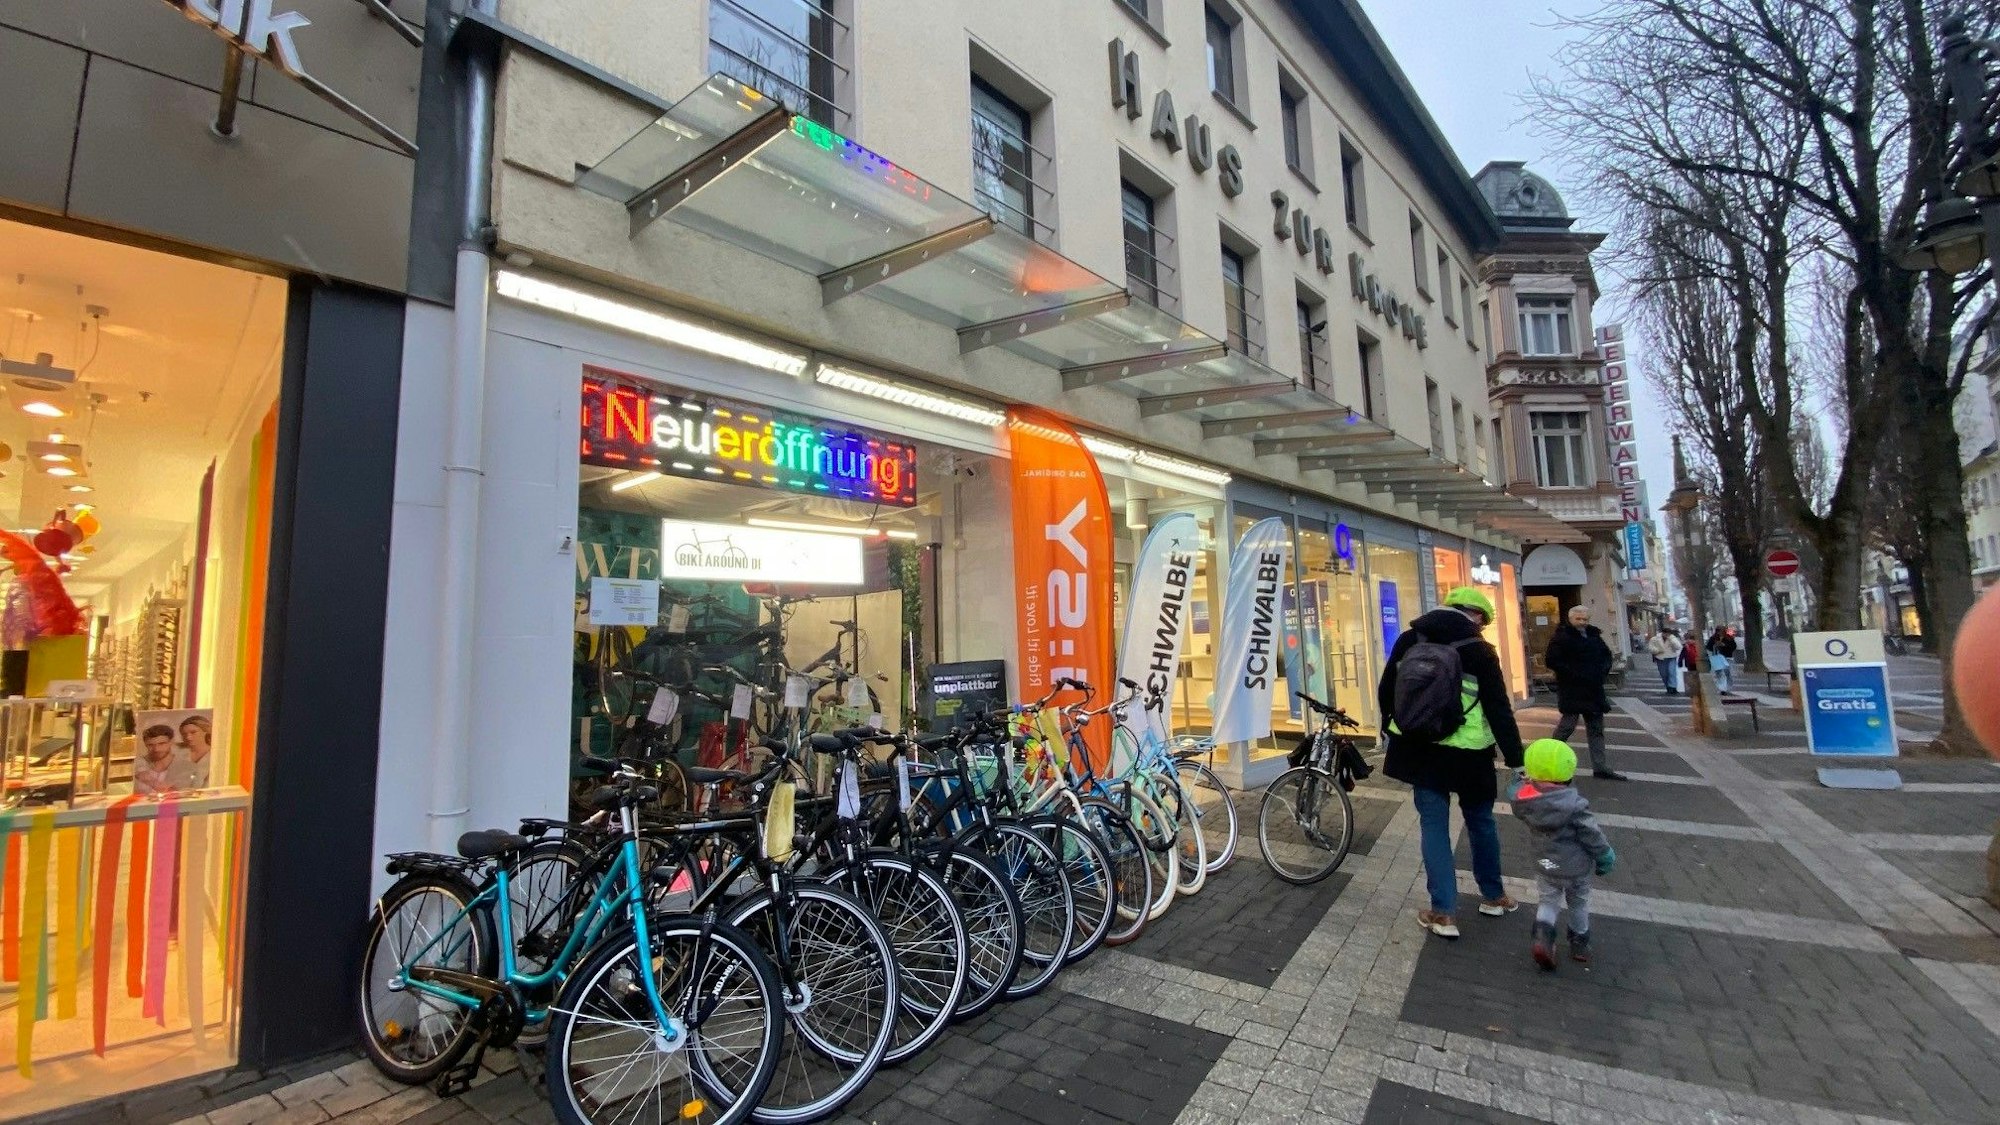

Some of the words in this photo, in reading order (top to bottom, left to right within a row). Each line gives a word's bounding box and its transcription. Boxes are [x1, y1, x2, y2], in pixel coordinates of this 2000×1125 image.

[1108, 37, 1243, 199] HAUS
[1270, 188, 1335, 275] ZUR
[1348, 250, 1428, 351] KRONE
[604, 391, 900, 493] Neueröffnung
[1603, 326, 1640, 522] LEDERWAREN
[679, 552, 704, 567] BIKE
[704, 553, 749, 569] AROUND
[1145, 551, 1192, 713] SCHWALBE
[1245, 552, 1281, 690] SCHWALBE
[934, 680, 999, 694] unplattbar
[1818, 699, 1877, 710] Gratis
